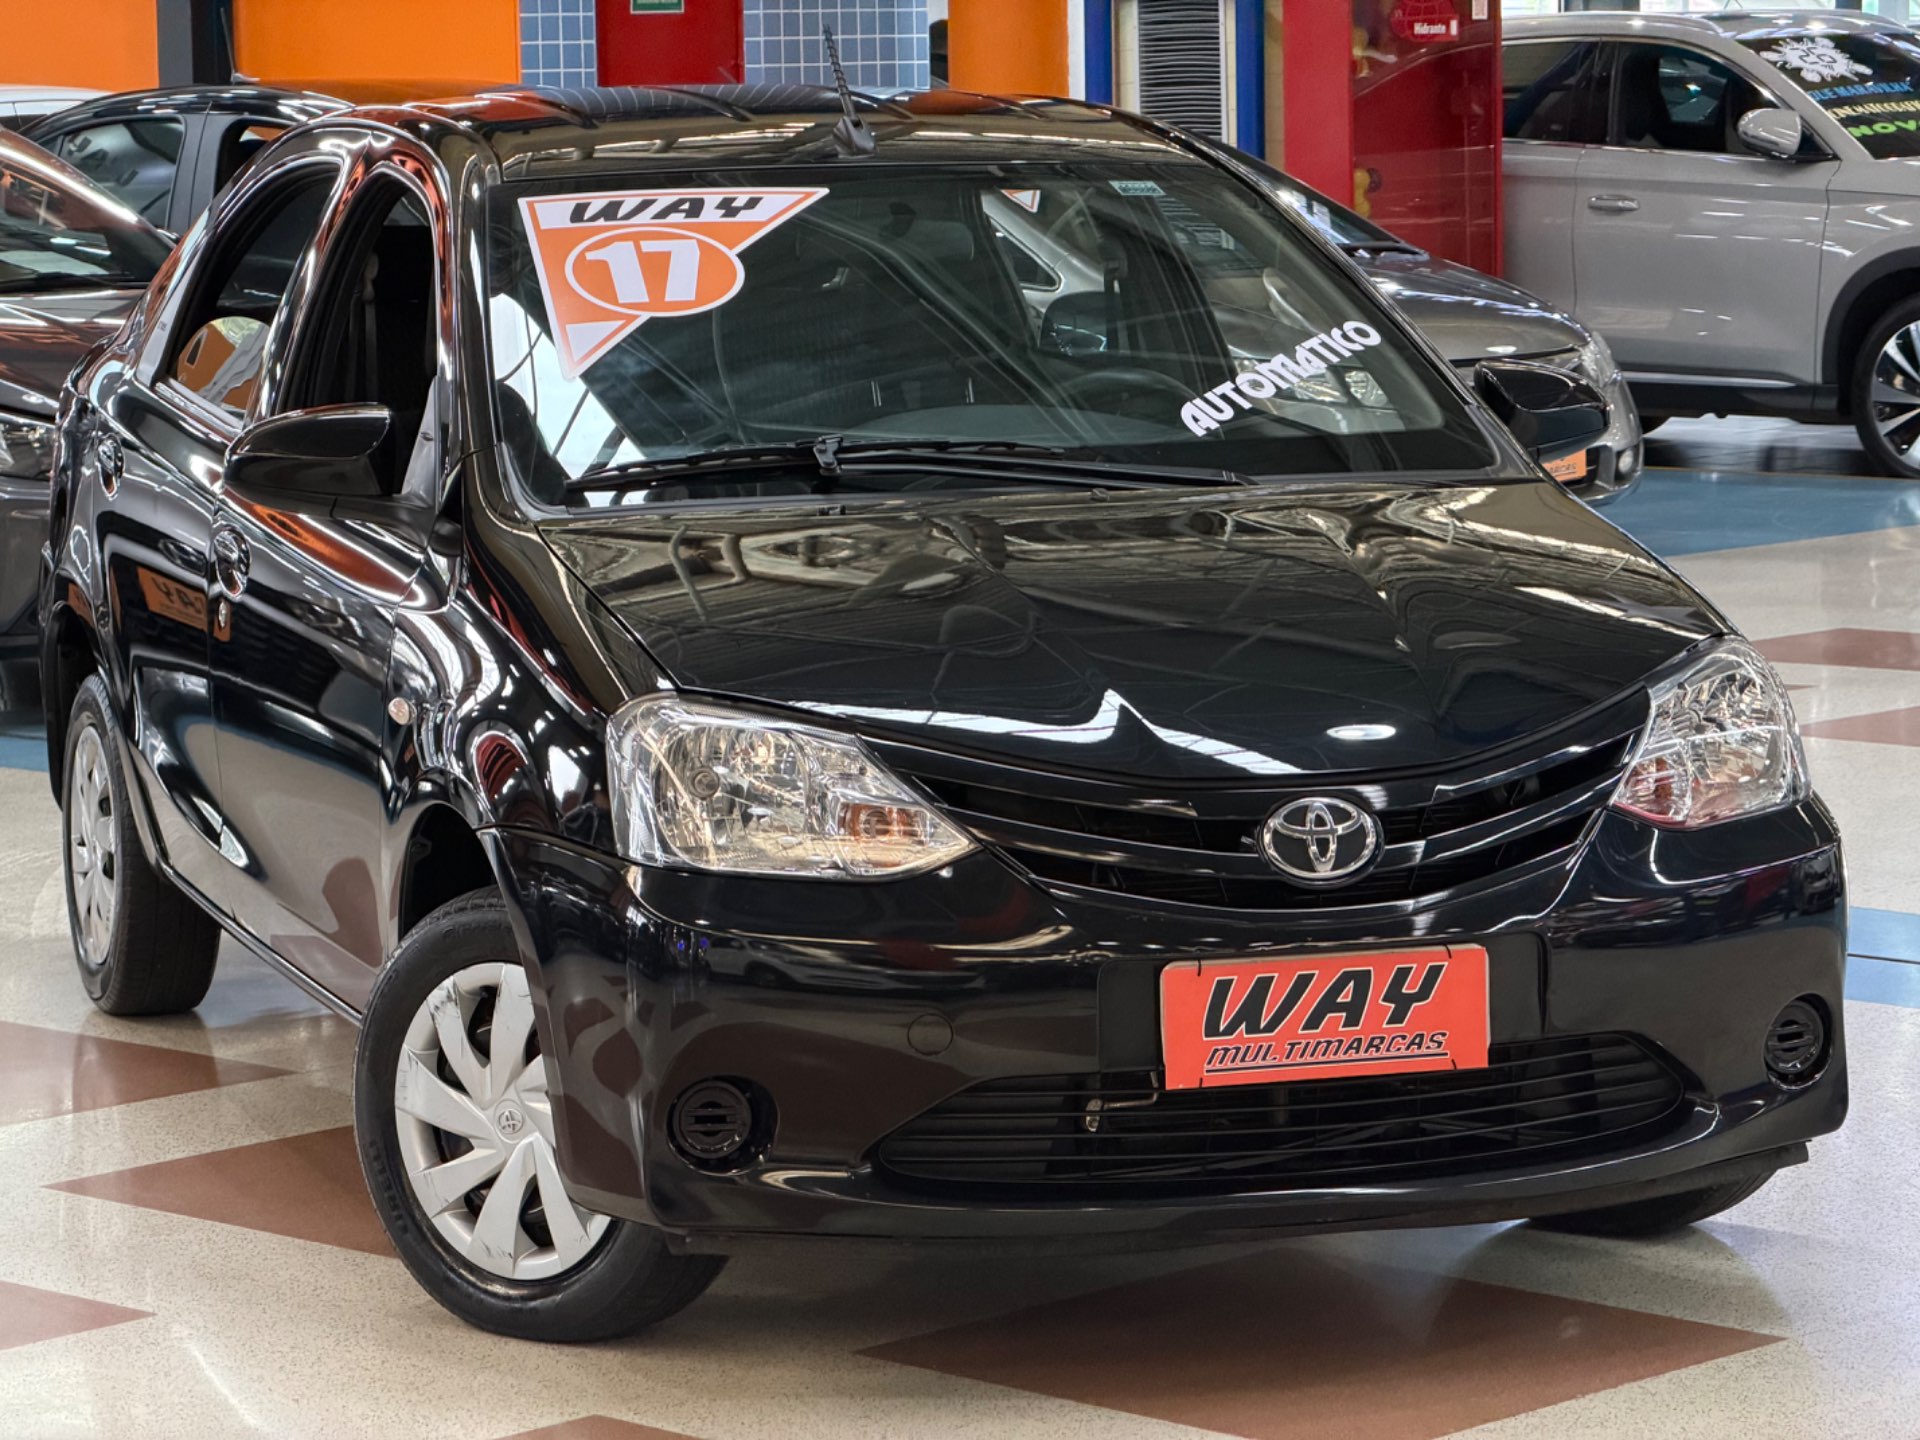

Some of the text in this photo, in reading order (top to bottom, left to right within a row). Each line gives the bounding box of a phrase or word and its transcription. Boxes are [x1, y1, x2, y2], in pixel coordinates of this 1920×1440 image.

[569, 196, 764, 224] WAY
[585, 239, 700, 304] 17
[1180, 320, 1382, 438] AUTOMATICO
[1202, 961, 1449, 1040] WAY
[1204, 1031, 1448, 1069] MULTIMARCAS
